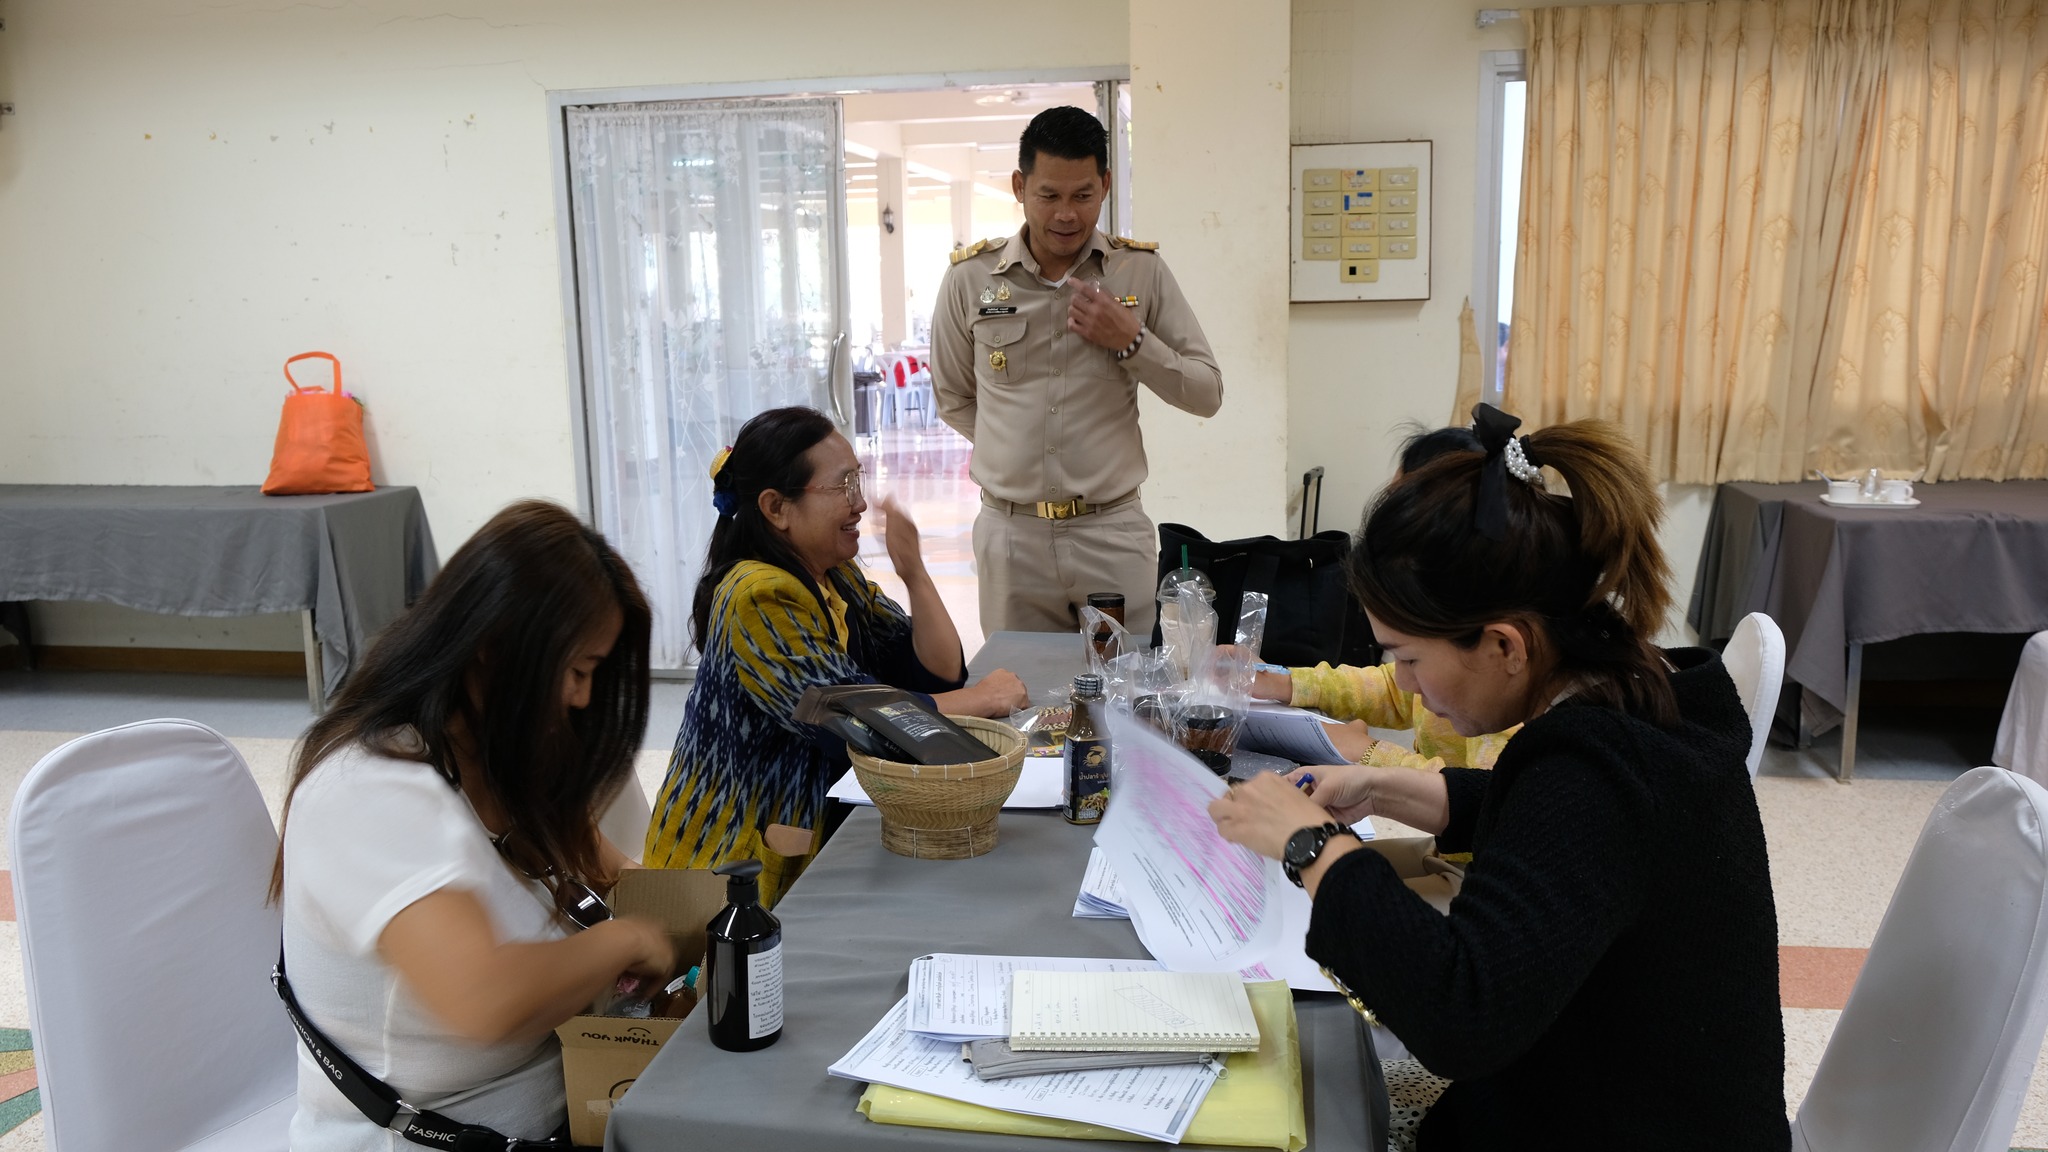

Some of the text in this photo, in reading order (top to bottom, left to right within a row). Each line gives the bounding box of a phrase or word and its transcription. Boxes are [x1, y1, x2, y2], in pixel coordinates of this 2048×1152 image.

[581, 1032, 660, 1046] THANK YOU
[315, 1048, 322, 1058] &
[322, 1056, 343, 1080] BAG
